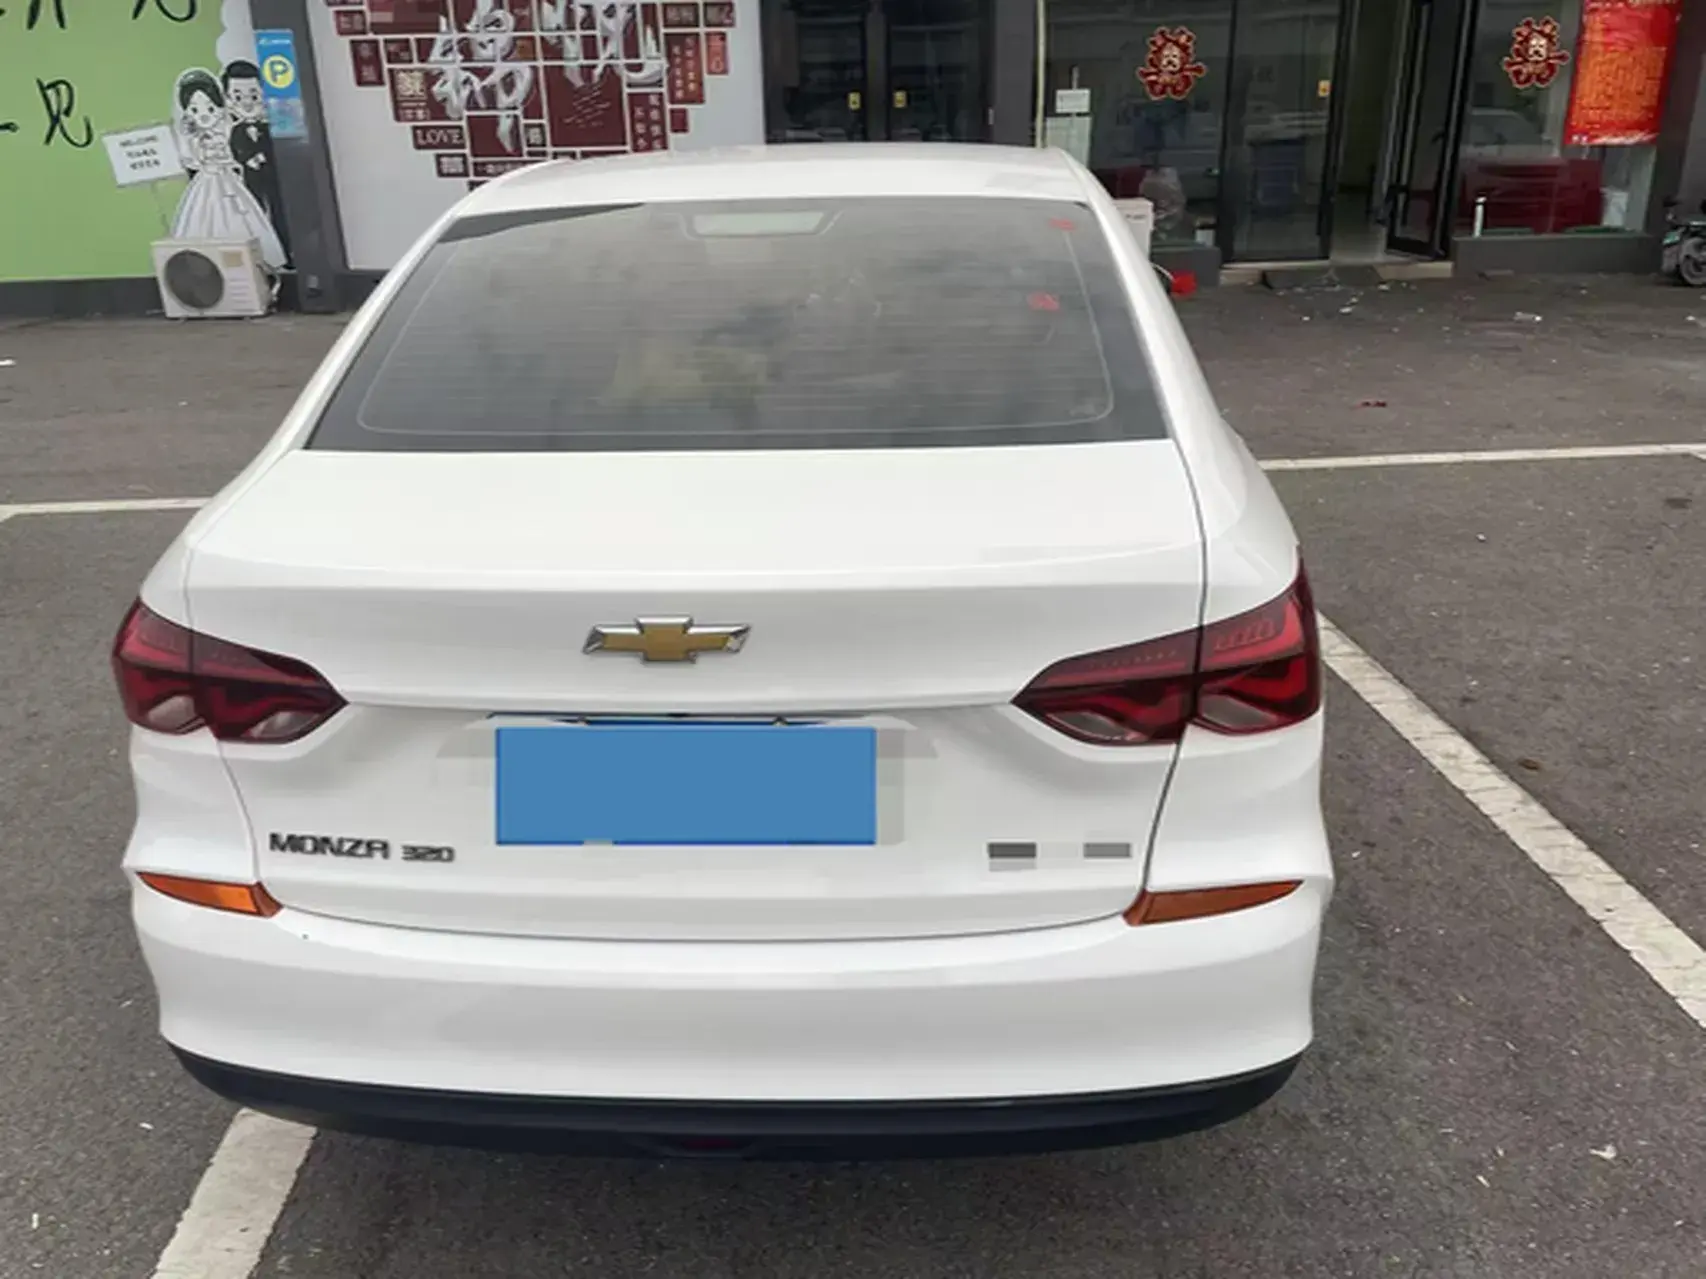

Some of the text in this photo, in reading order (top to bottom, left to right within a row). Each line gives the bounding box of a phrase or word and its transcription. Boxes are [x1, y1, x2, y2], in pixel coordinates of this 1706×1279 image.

[269, 60, 289, 83] P
[416, 129, 463, 146] LOVE
[269, 832, 455, 862] MONZA 320
